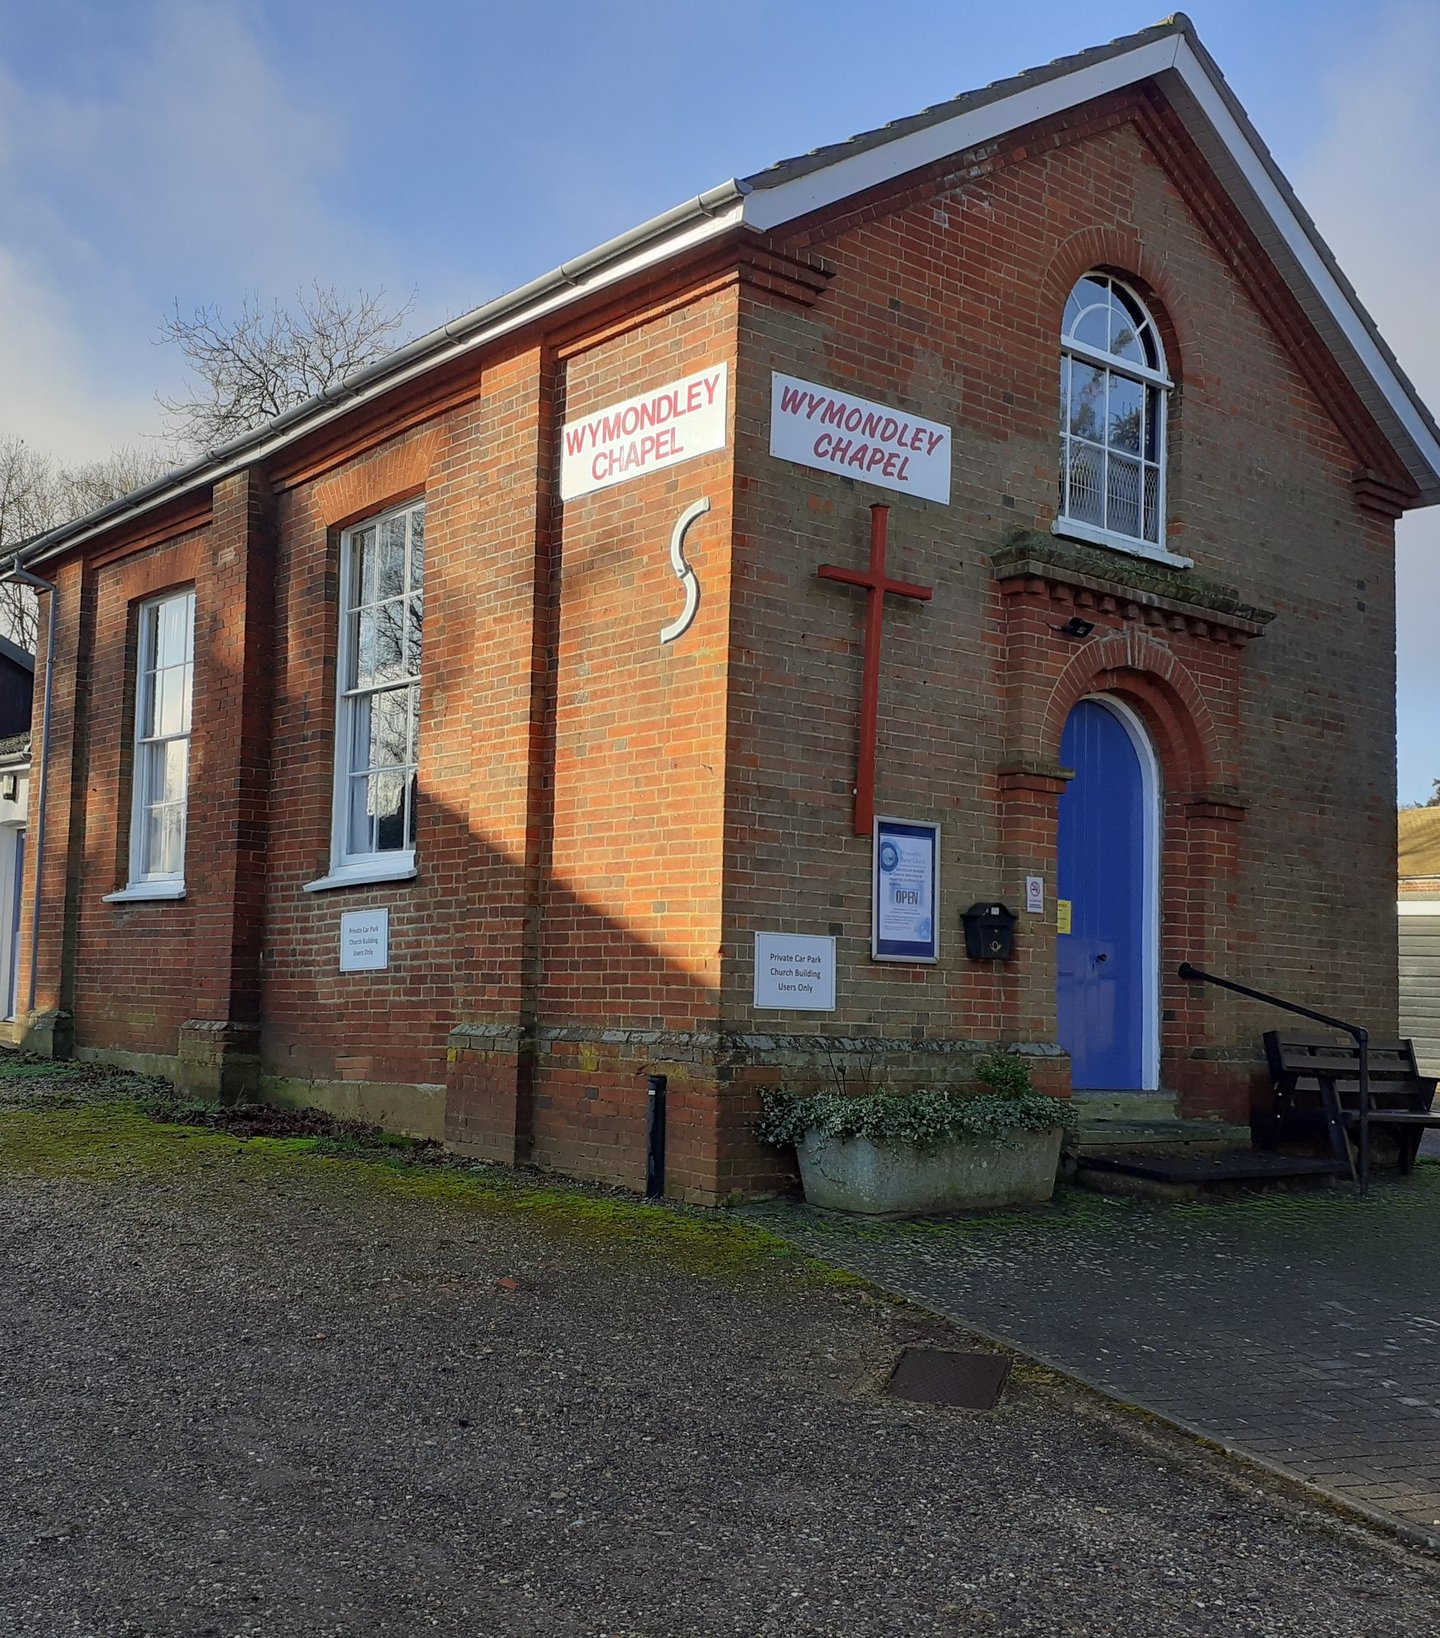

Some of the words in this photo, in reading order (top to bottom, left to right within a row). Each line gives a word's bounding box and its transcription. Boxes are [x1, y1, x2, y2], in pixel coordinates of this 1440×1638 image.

[566, 373, 720, 457] WYMONDLEY
[780, 385, 944, 456] WYMONDLEY
[591, 427, 684, 481] CHAPEL
[813, 433, 910, 481] CHAPEL
[895, 890, 919, 905] OPEN
[770, 953, 794, 962] Private
[794, 954, 806, 963] Car
[807, 955, 822, 964] Park
[770, 967, 794, 977] Church
[795, 968, 821, 980] Building
[778, 982, 797, 992] Users
[797, 983, 814, 994] Only
